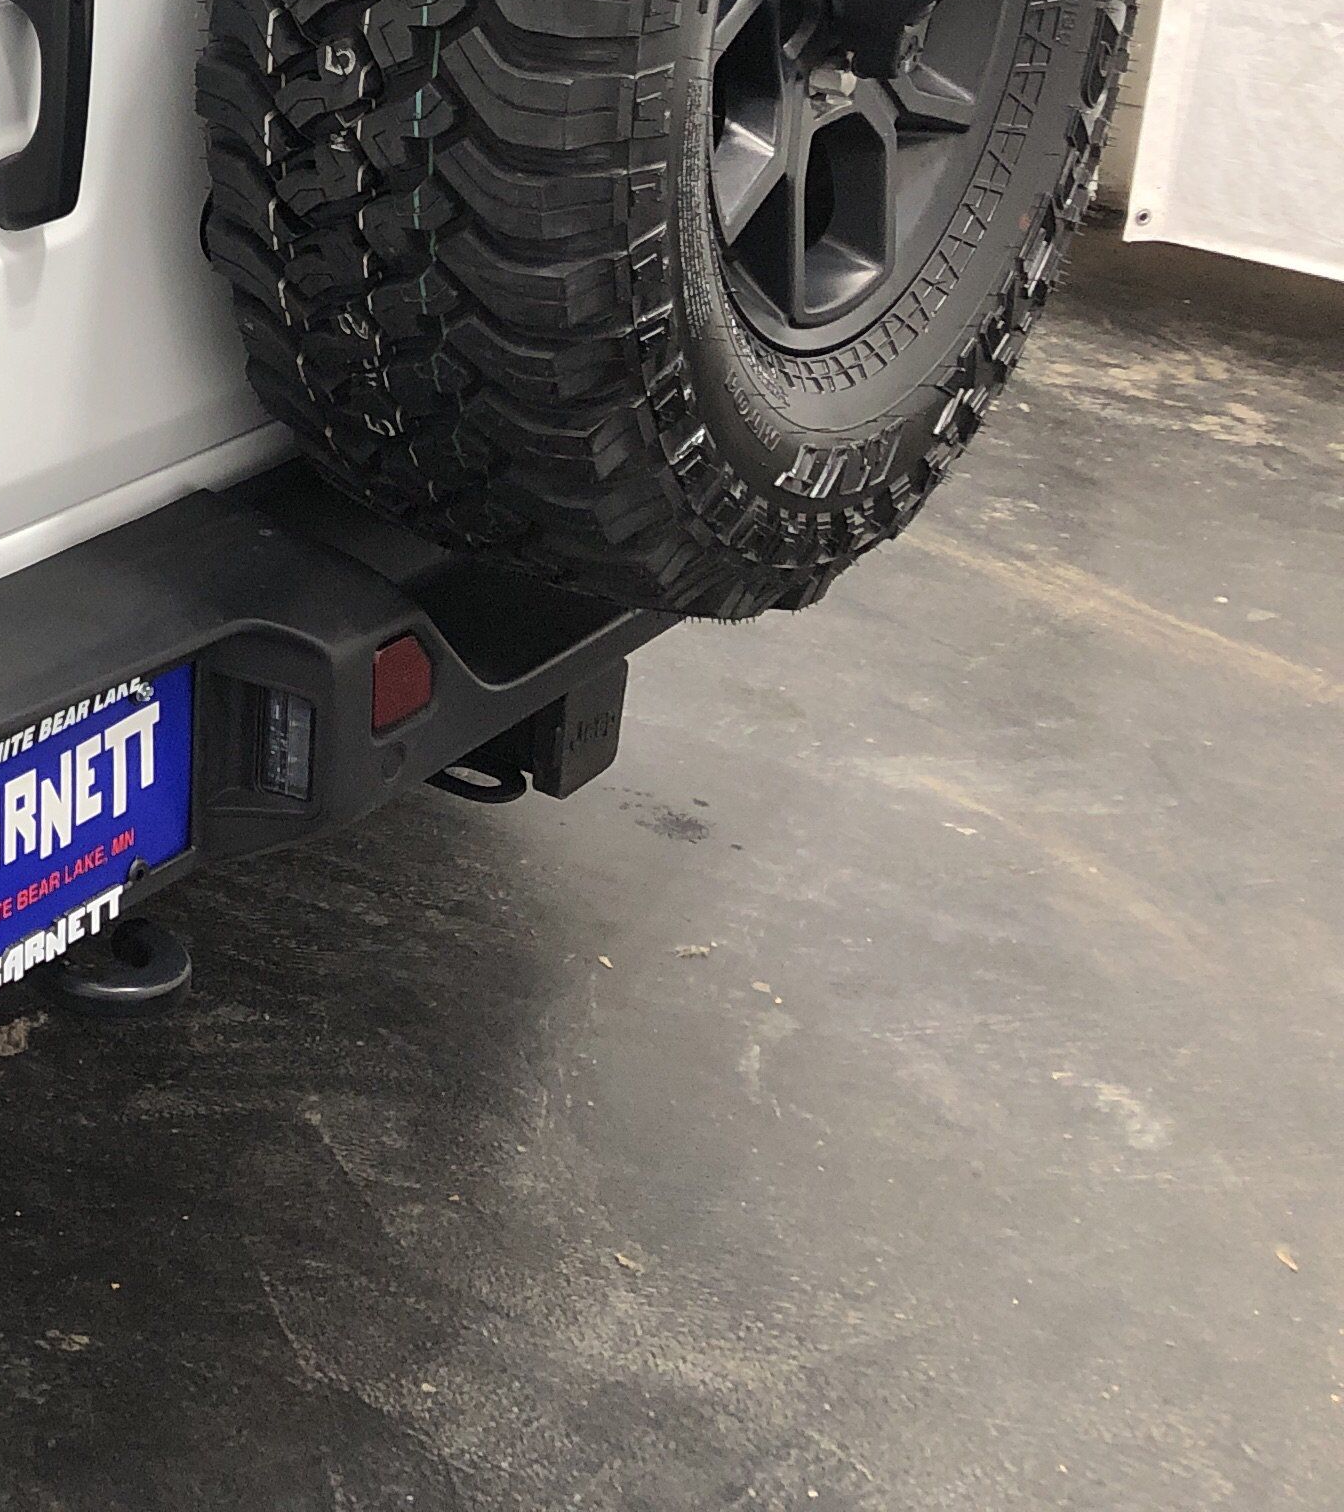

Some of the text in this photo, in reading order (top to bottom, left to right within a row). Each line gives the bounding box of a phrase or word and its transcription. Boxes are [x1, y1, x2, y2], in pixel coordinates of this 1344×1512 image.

[38, 698, 91, 743] BEAR
[92, 676, 142, 714] LAKE
[16, 870, 61, 911] BEAR
[64, 844, 109, 885] LAKE,
[111, 827, 136, 856] MN
